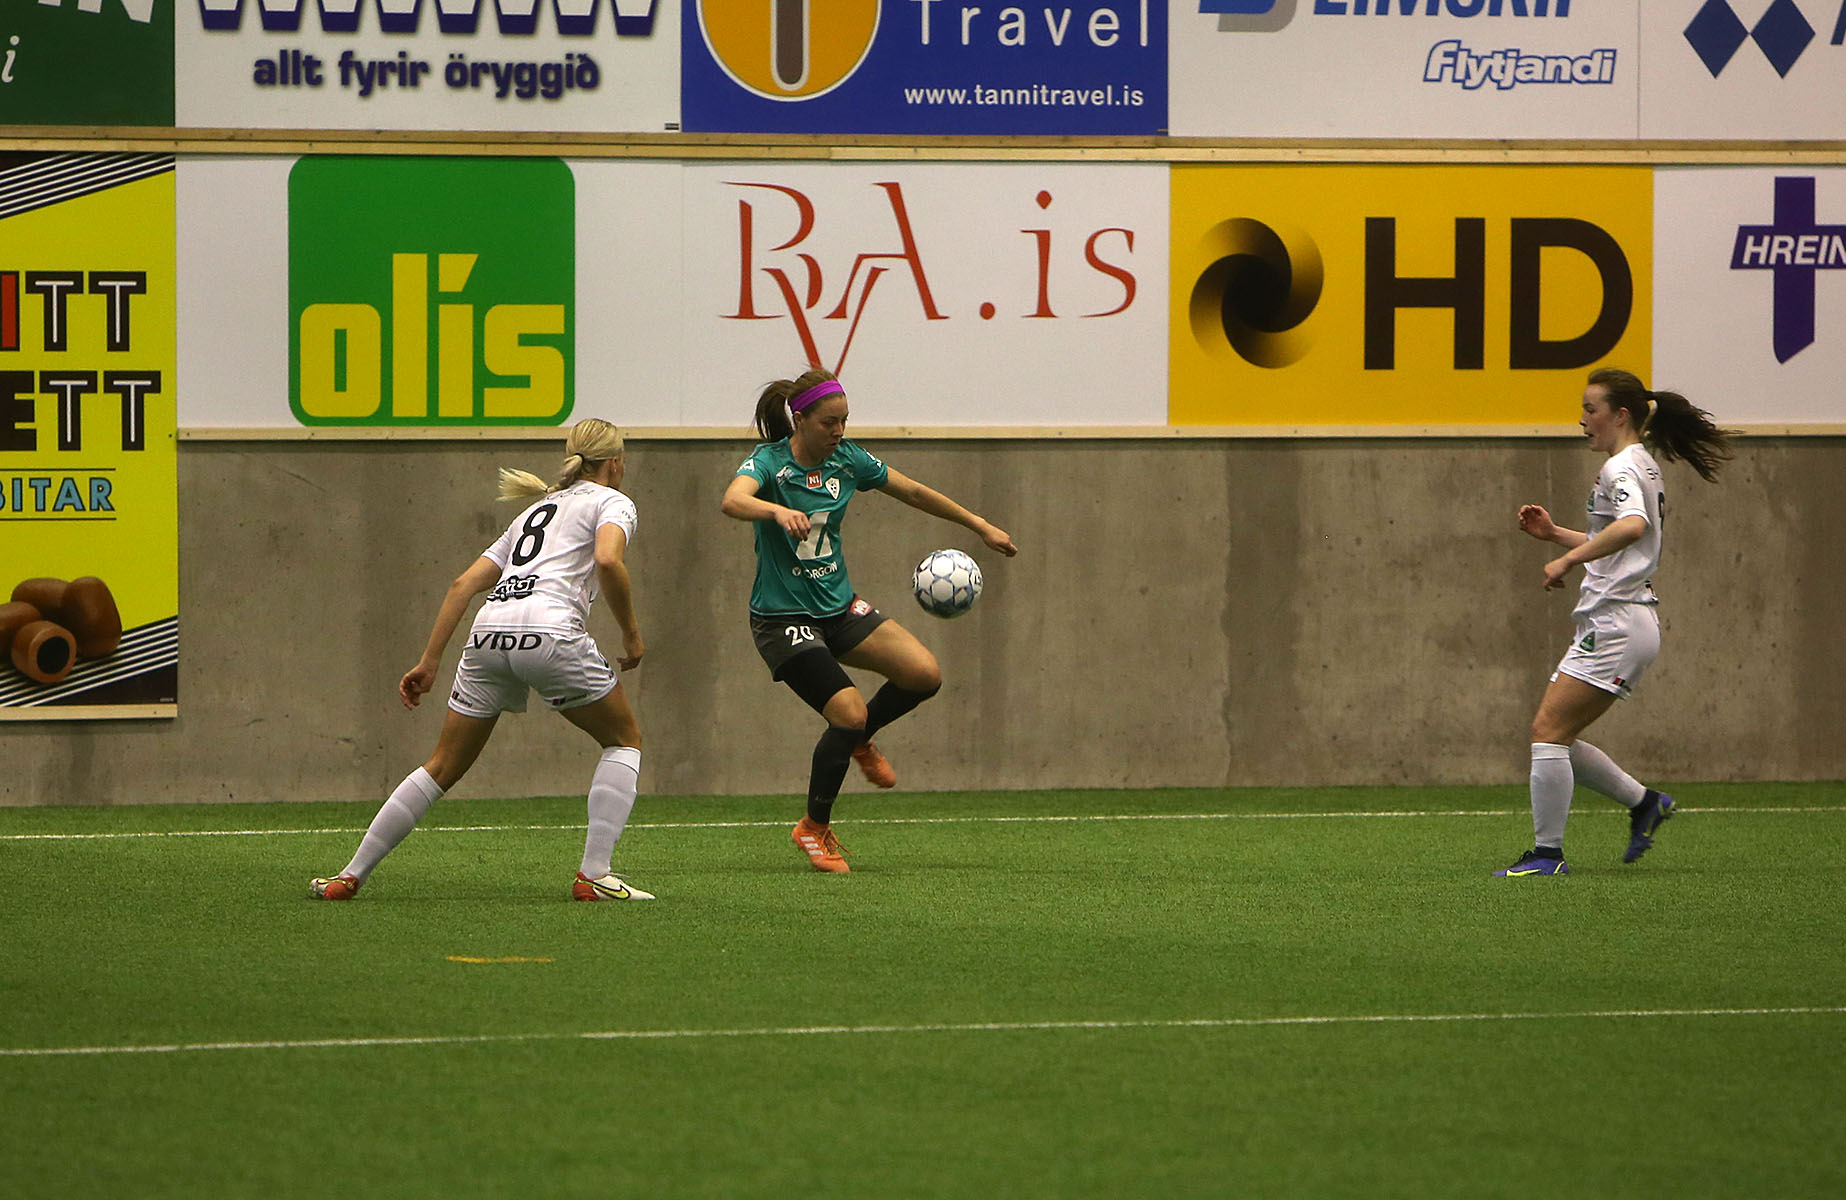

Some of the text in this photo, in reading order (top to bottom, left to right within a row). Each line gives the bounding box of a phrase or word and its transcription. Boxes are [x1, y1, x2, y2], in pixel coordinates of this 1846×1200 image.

[907, 0, 1149, 47] Travel
[253, 50, 600, 99] allt fyrir öryggið
[1423, 40, 1617, 90] Flytjandi
[904, 84, 1145, 106] www.tannitravel.is
[1364, 217, 1634, 370] HD
[300, 253, 565, 418] olís
[0, 477, 116, 512] ITAR
[511, 503, 558, 567] 8
[784, 625, 815, 646] 20
